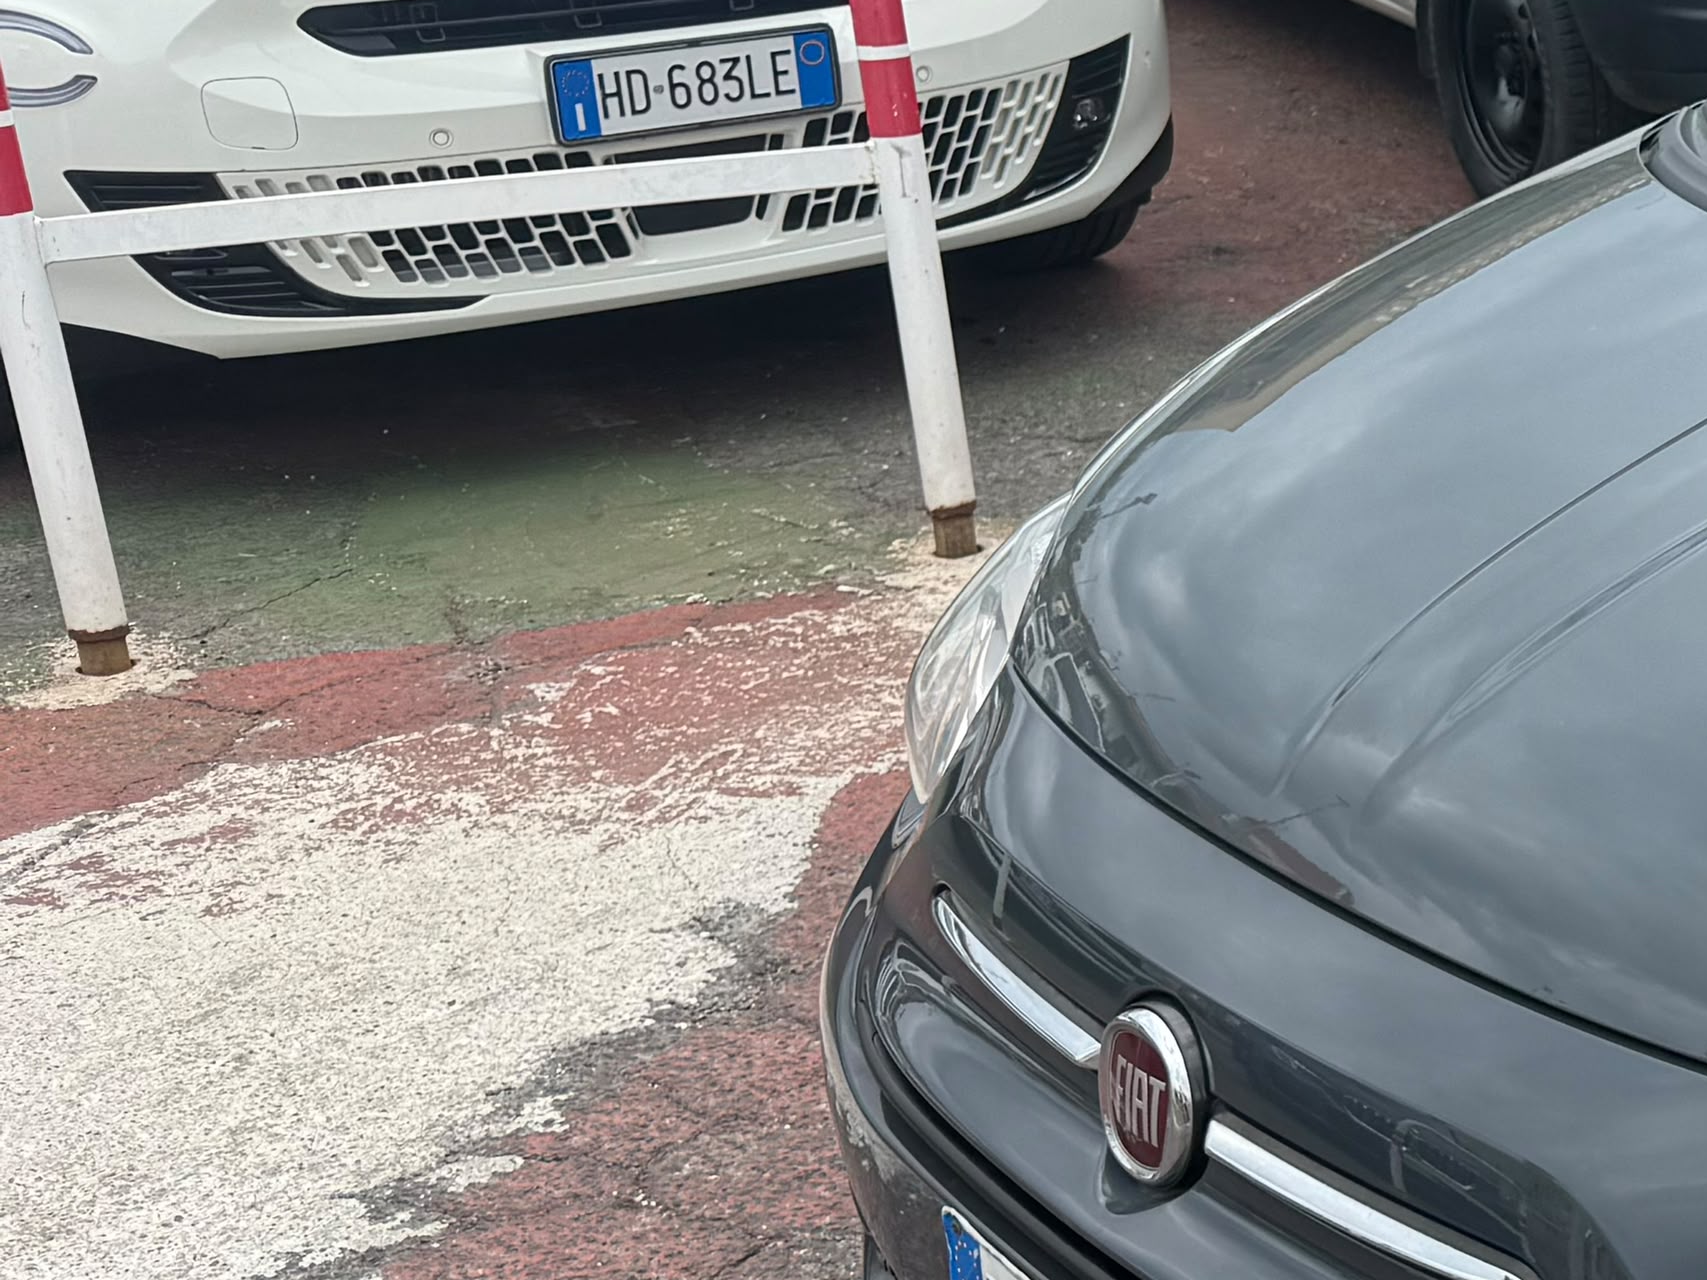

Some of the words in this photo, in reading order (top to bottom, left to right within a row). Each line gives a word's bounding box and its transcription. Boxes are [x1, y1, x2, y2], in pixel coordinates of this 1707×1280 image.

[597, 67, 652, 120] HD
[667, 48, 797, 111] 683LE
[1112, 1053, 1168, 1148] FIAT
